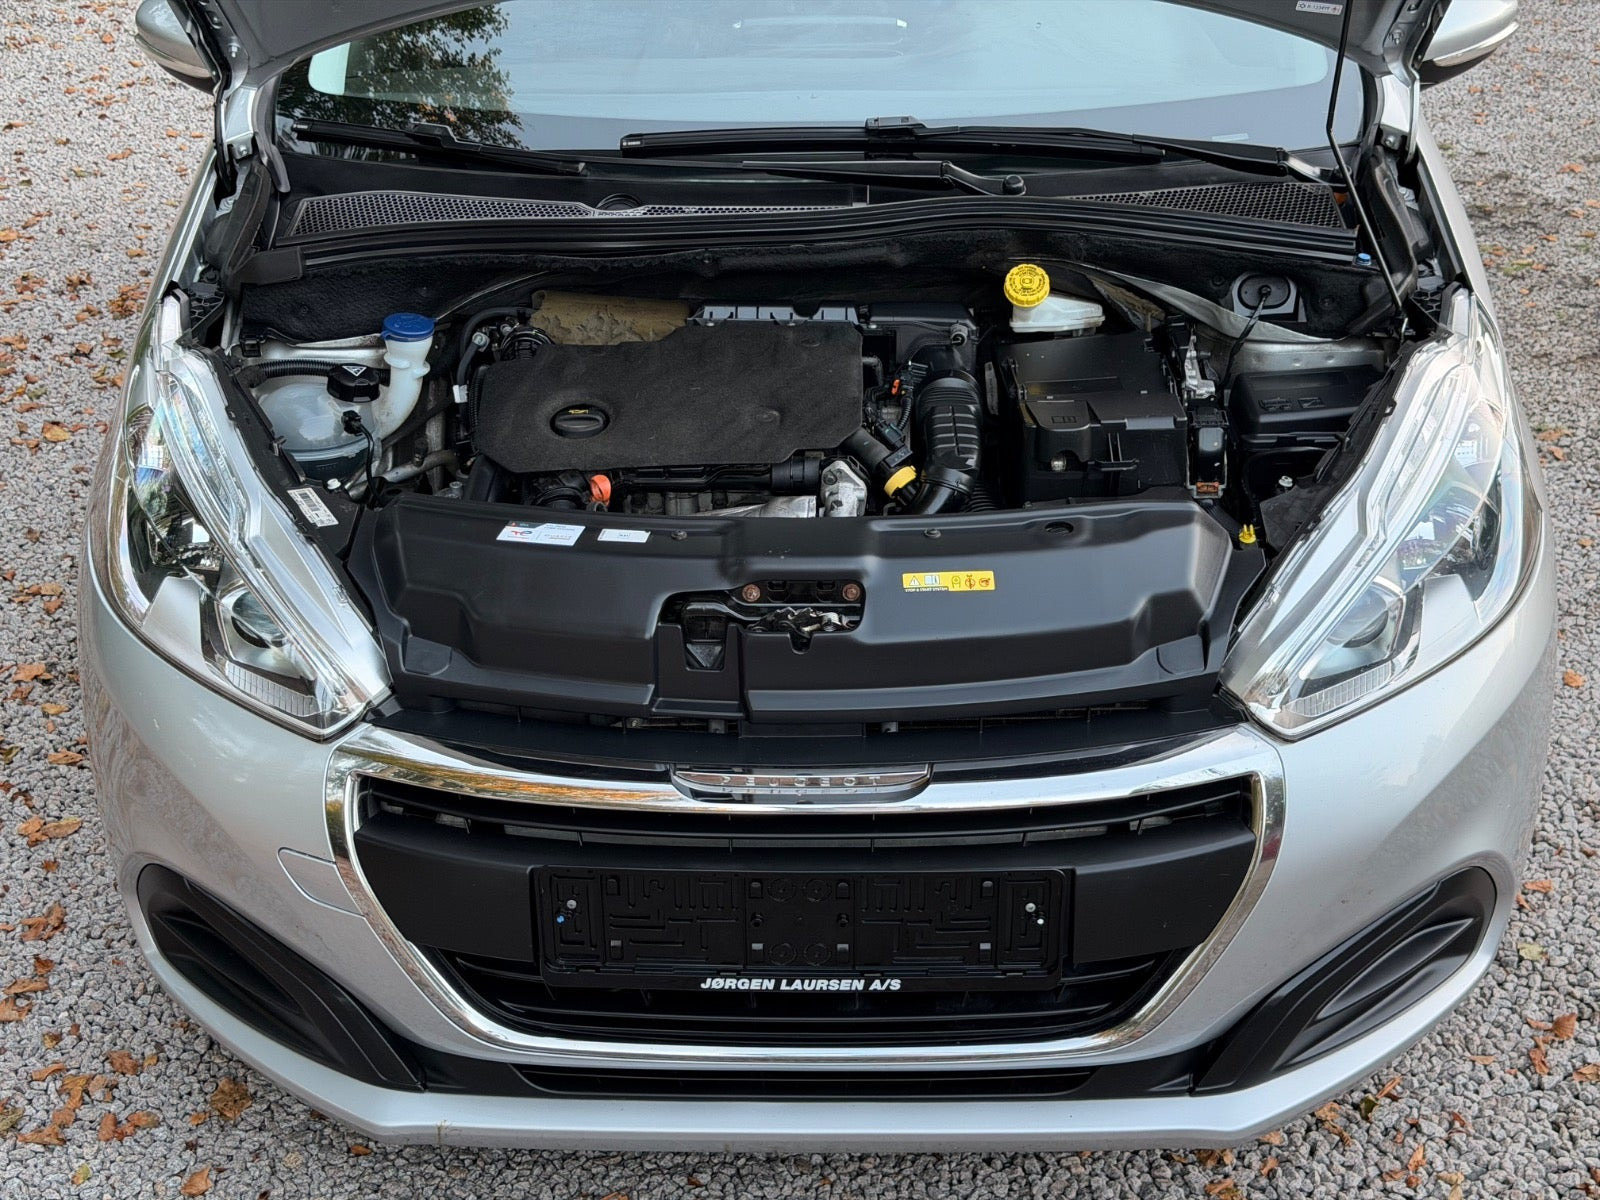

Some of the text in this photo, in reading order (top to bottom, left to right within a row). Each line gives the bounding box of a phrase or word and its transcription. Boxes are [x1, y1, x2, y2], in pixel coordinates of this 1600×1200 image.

[720, 775, 881, 788] PEUGEOT
[700, 977, 902, 991] JØRGEN LAURSEN A/S
